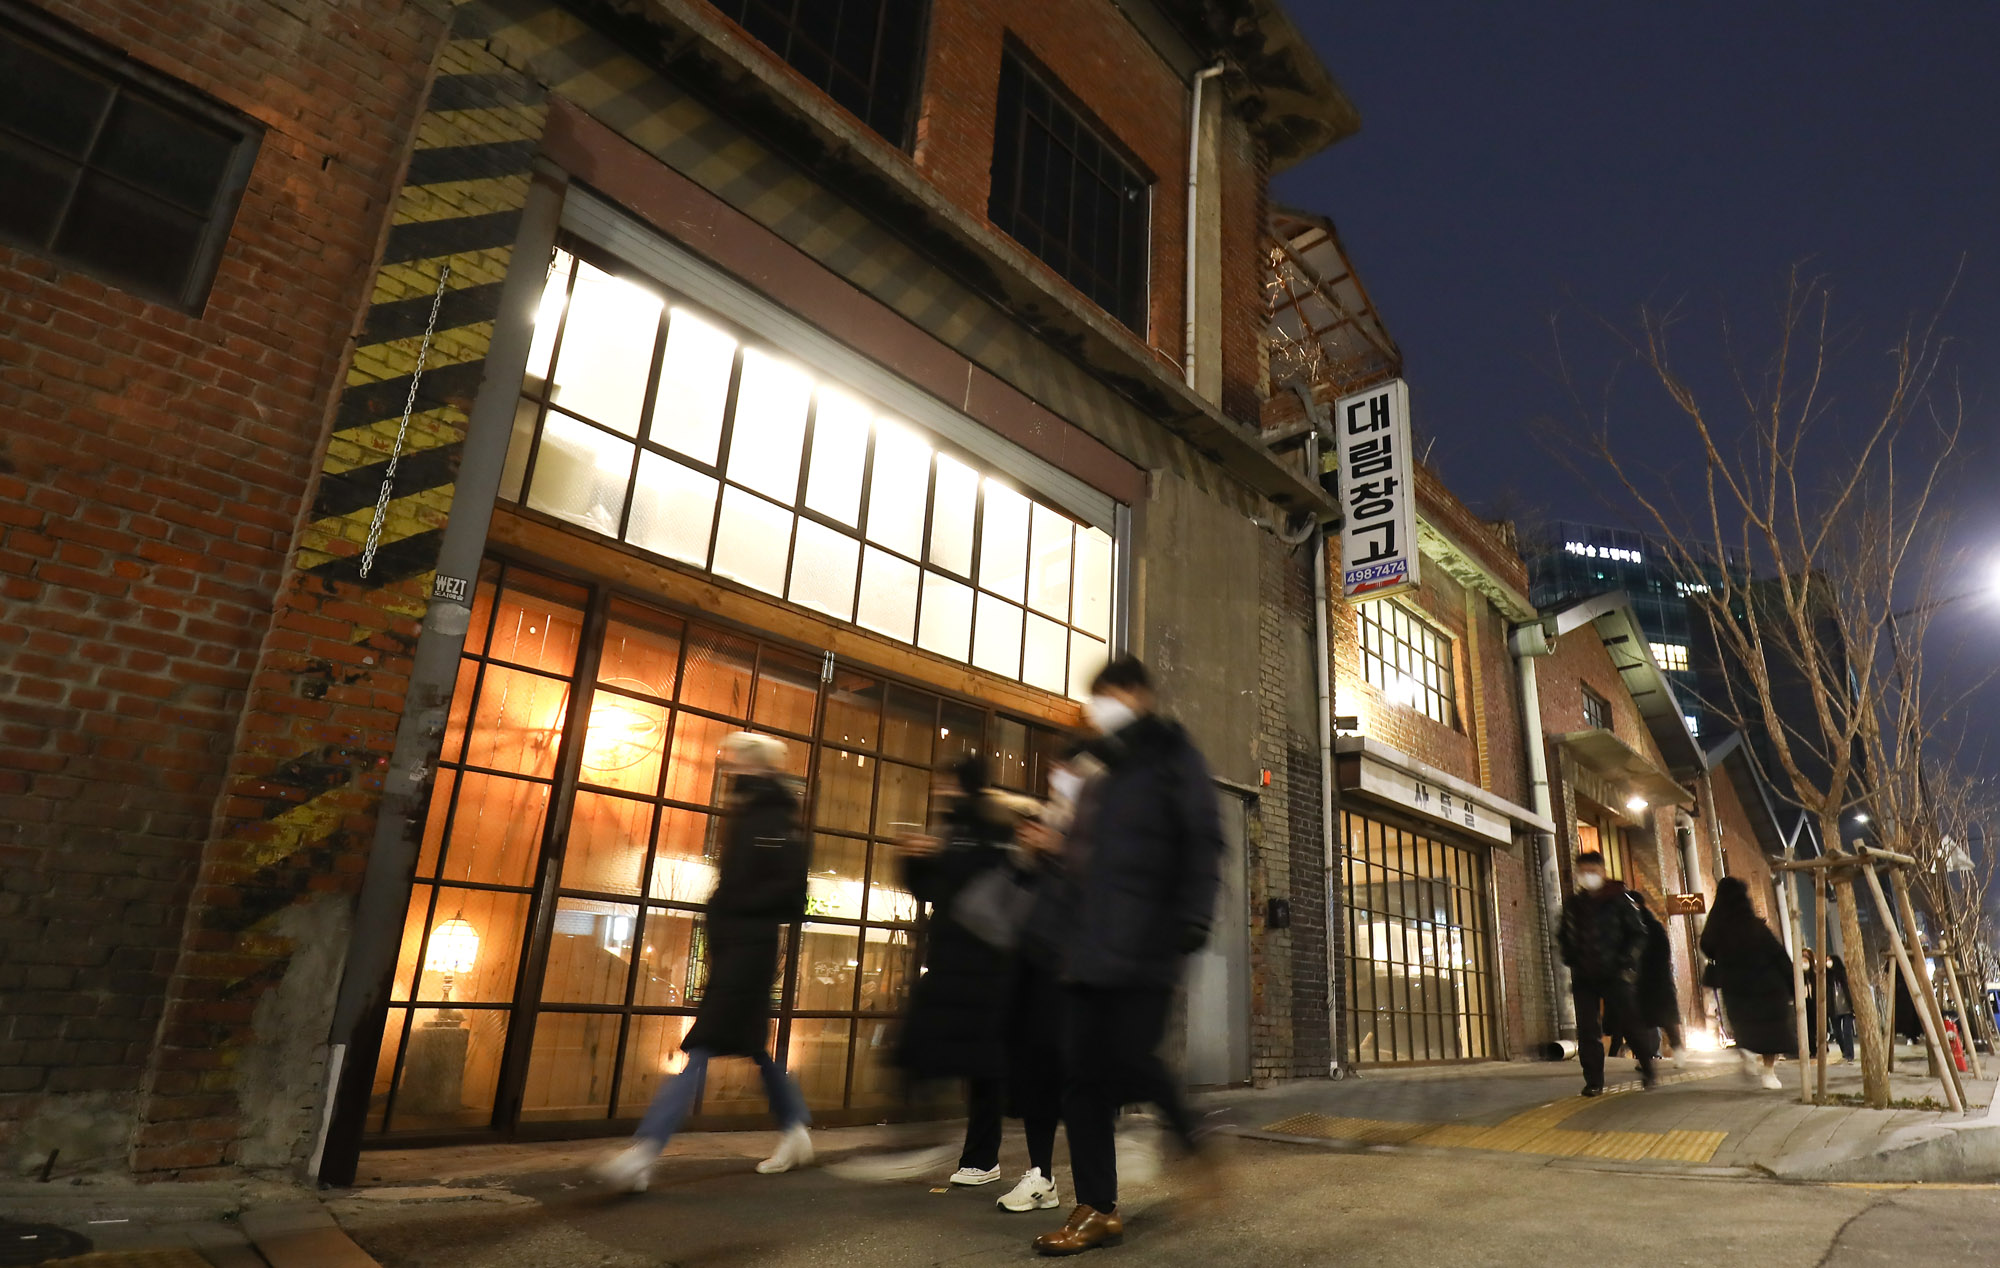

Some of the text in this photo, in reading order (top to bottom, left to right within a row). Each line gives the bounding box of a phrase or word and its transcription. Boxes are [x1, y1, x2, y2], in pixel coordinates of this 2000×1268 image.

[1347, 393, 1398, 566] 대림창고
[1347, 561, 1405, 583] 498-7474
[436, 575, 467, 595] WEZT
